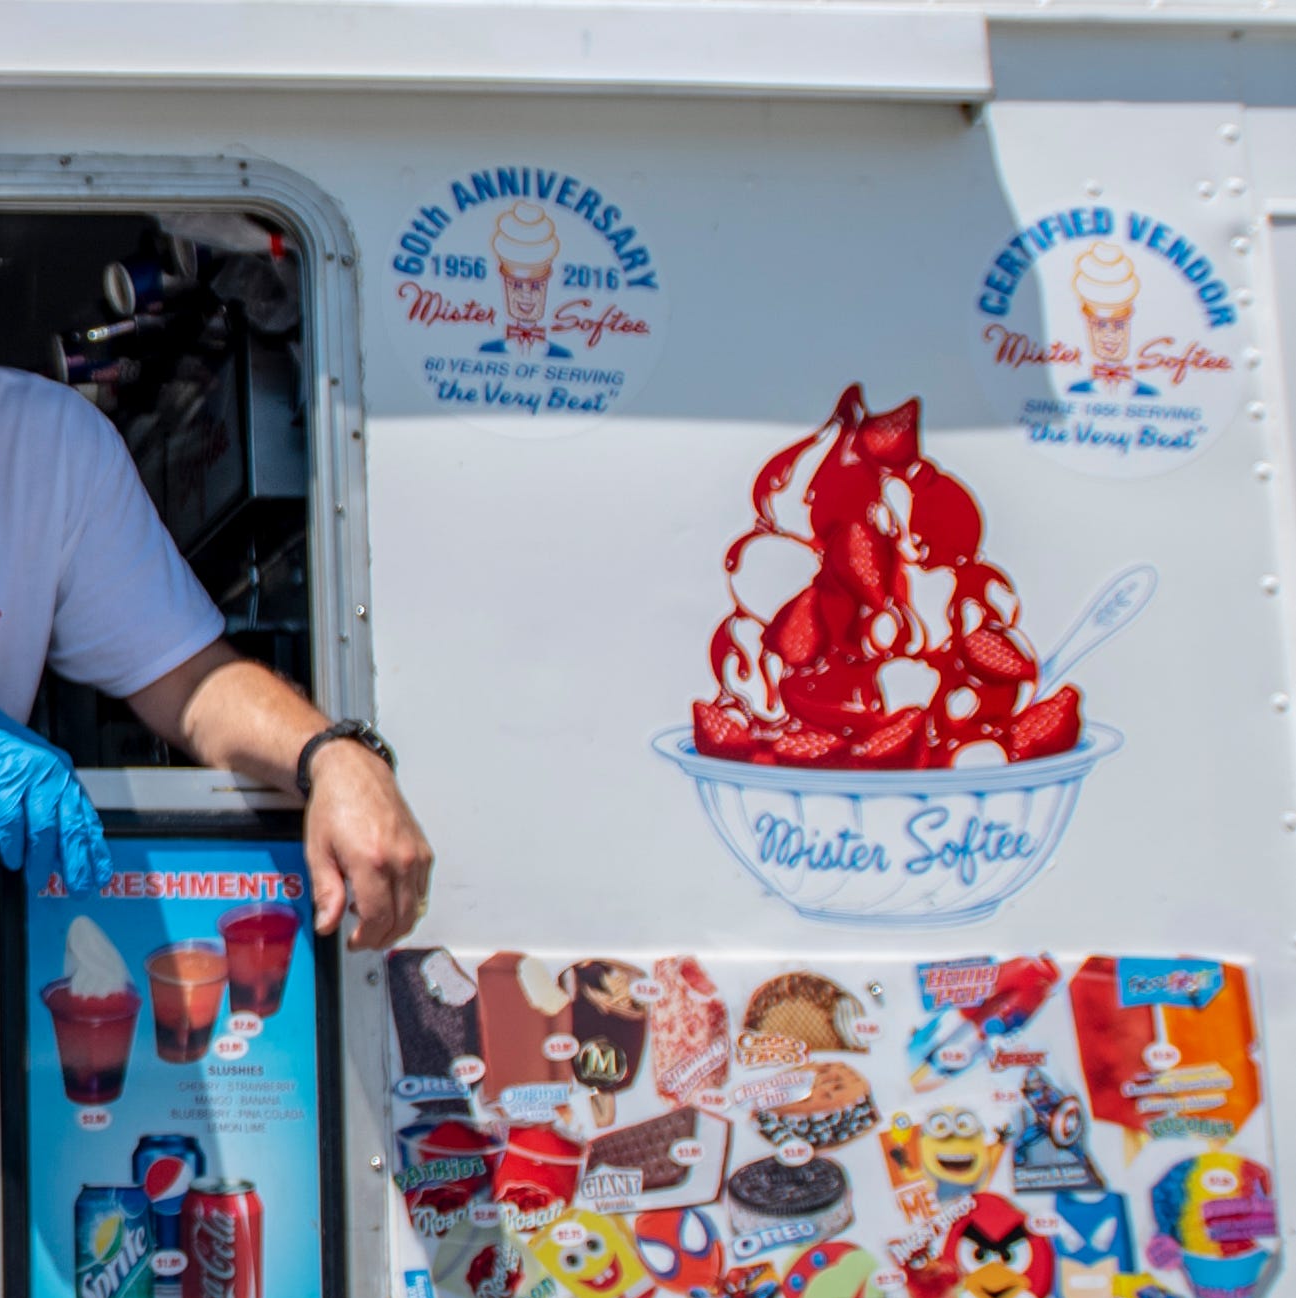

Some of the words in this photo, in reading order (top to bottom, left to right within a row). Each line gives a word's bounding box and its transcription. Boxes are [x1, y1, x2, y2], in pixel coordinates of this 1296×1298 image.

[392, 204, 451, 276] 60th
[450, 166, 659, 290] ANNIVERSARY
[430, 253, 488, 280] 1956
[563, 263, 620, 291] 2016
[978, 206, 1113, 317] CERTIFIED
[1127, 211, 1237, 329] VENDOR
[397, 281, 496, 326] Mister
[551, 299, 651, 348] Softee
[983, 323, 1082, 369] Mister
[1136, 337, 1233, 386] Softee
[425, 357, 444, 371] 60
[450, 359, 510, 376] YEARS
[515, 363, 540, 378] OF
[545, 367, 624, 386] SERVING
[484, 381, 541, 415] Very
[1025, 399, 1078, 415] SINCE
[1126, 402, 1202, 421] SERVING
[1076, 422, 1132, 454] Very
[755, 812, 890, 874] Mister
[904, 806, 1038, 887] Softee
[38, 871, 304, 899] RRESHMENTS
[208, 1066, 264, 1076] SLUSHIES
[581, 1172, 642, 1198] GIANT
[733, 1221, 816, 1259] OREO
